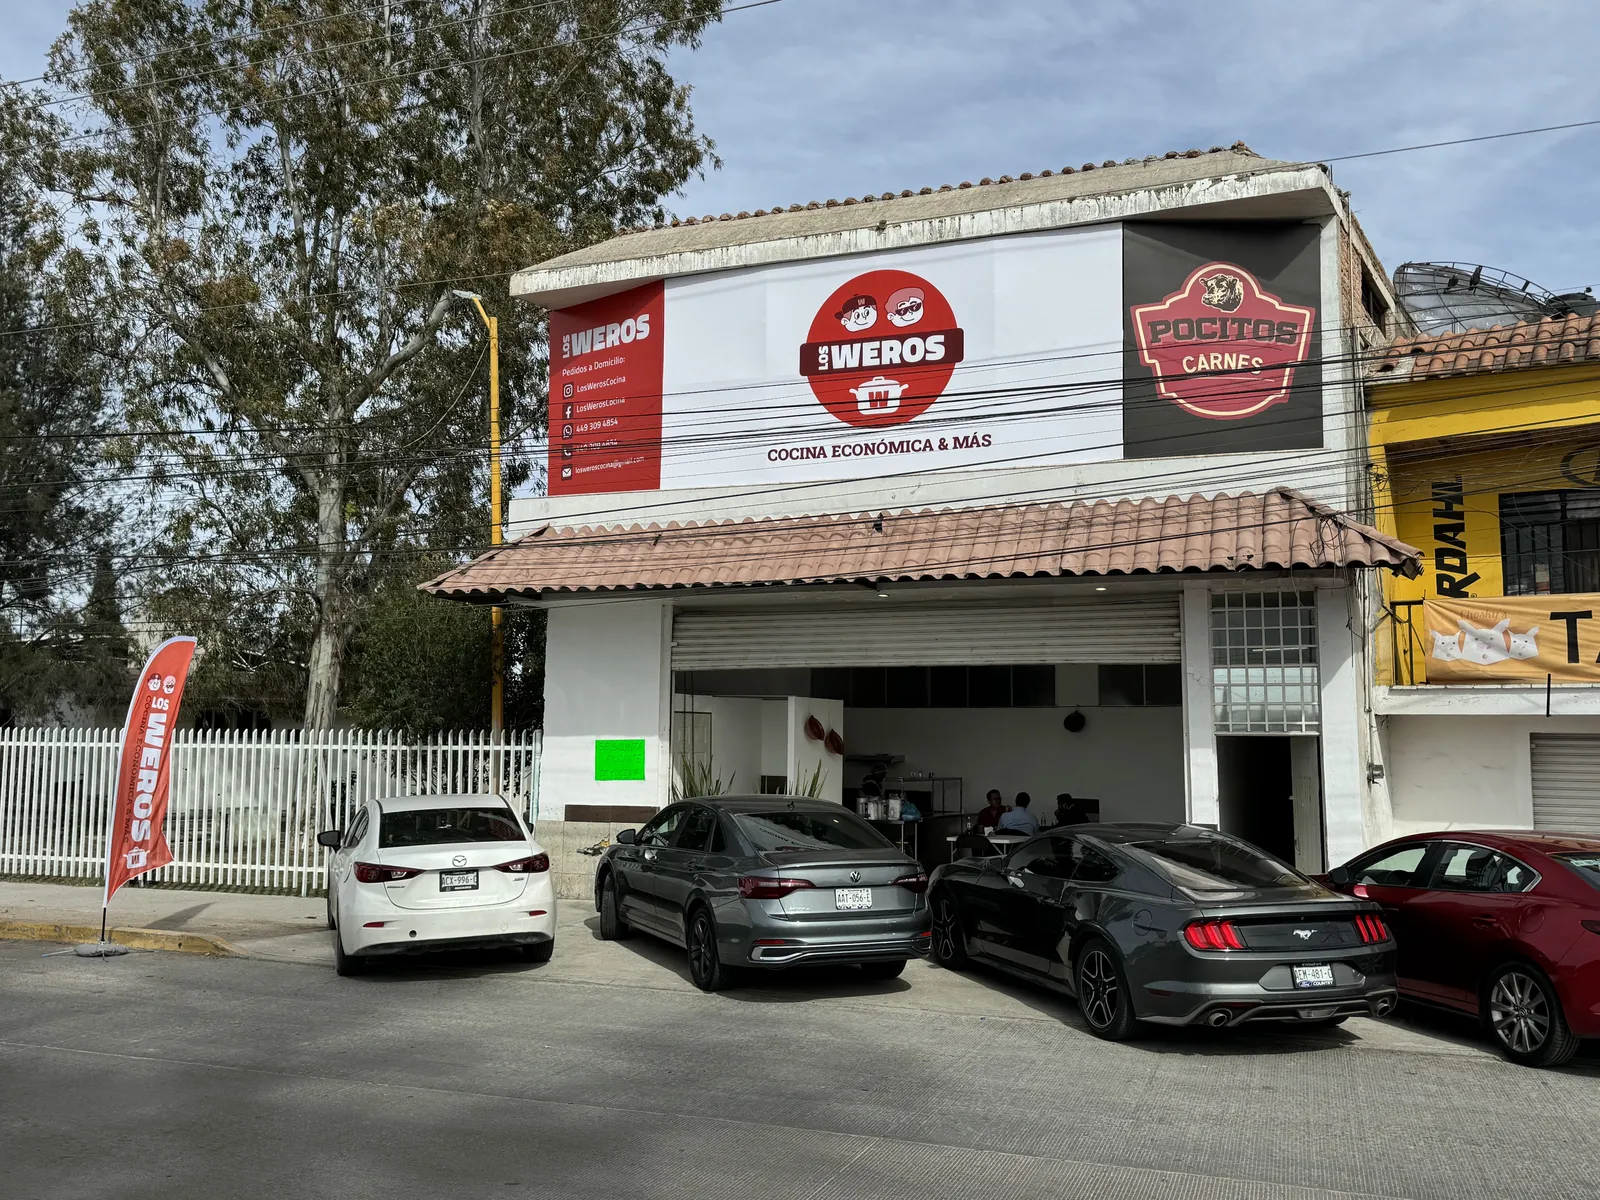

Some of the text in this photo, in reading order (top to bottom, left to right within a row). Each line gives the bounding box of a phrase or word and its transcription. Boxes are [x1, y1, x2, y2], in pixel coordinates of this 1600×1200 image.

[857, 298, 866, 306] W
[562, 313, 650, 359] LOS WEROS
[1147, 317, 1299, 347] POCITOS
[562, 365, 587, 377] Pedidos
[594, 356, 626, 370] Domicilio:
[818, 334, 945, 371] LOS WEROS
[1182, 352, 1264, 375] CARNES
[576, 375, 626, 393] LosWerosCocina
[868, 390, 889, 408] W
[576, 417, 619, 433] 449 309 4854
[767, 432, 992, 461] COCINA ECONÓMICA & MÁS
[1549, 609, 1600, 664] T
[139, 695, 151, 735] COCINA
[132, 696, 170, 842] LOS WEROS
